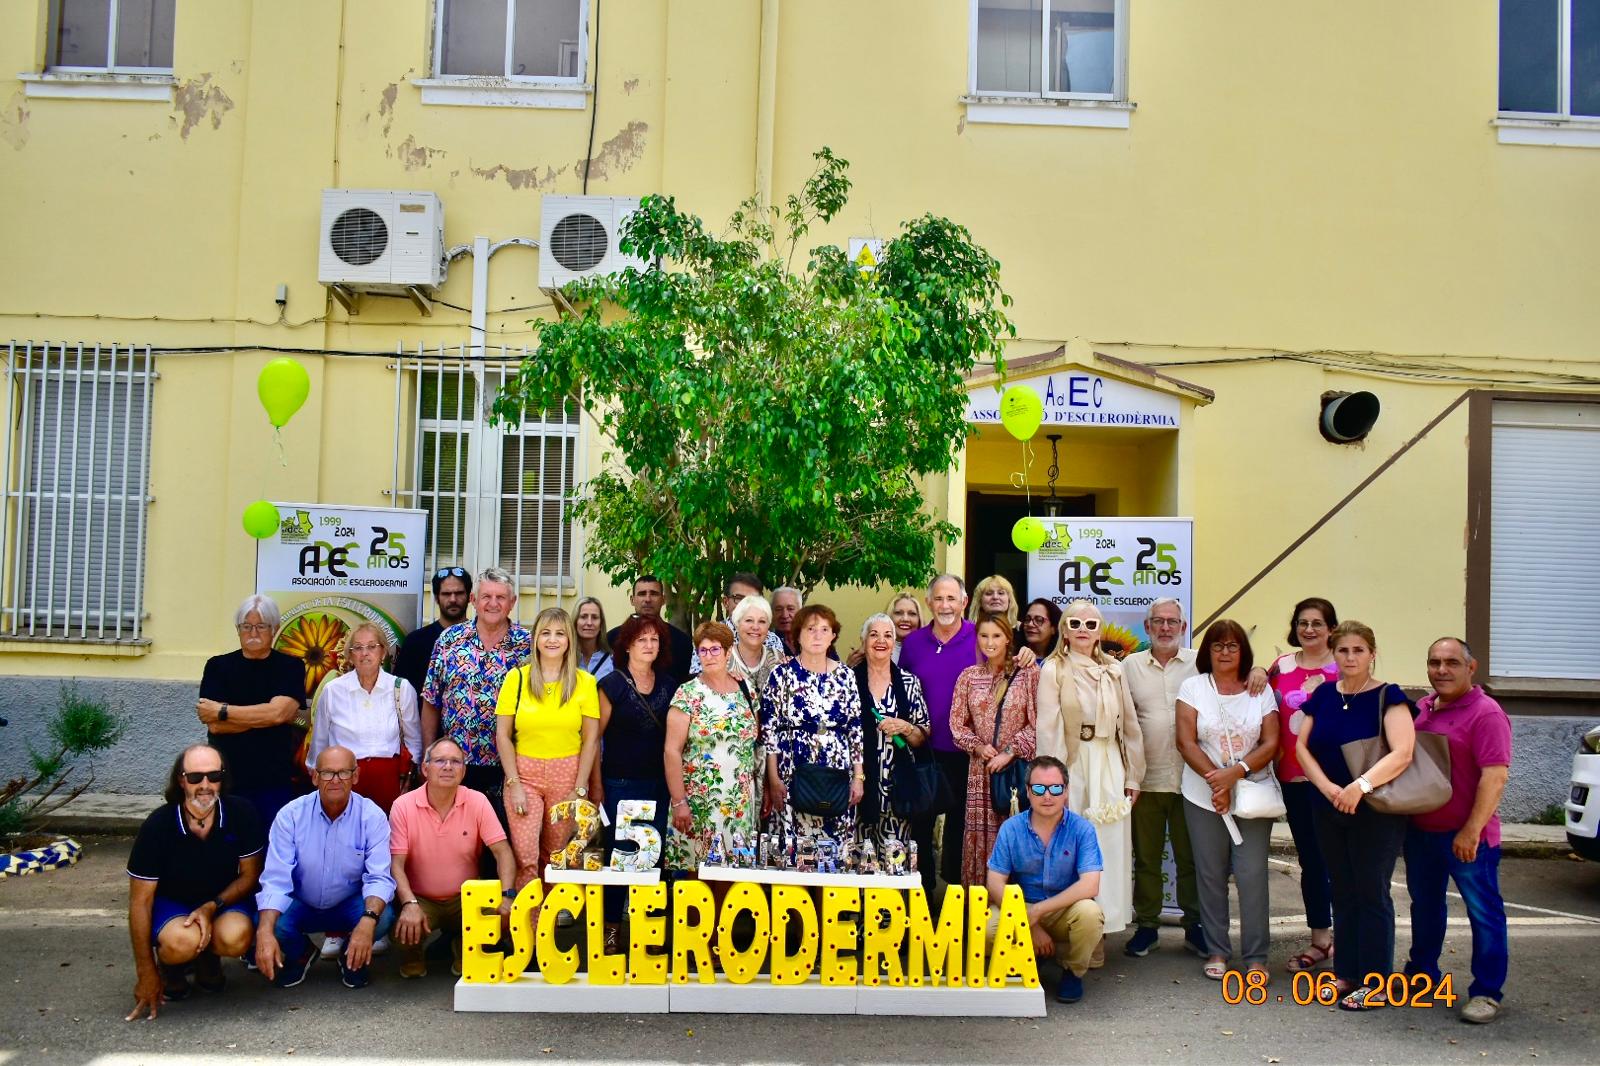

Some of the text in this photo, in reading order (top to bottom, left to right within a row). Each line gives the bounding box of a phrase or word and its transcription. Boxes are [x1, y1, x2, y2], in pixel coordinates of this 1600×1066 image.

[971, 408, 1176, 426] ASSOÓ D'ESCLERODÈRMIA
[371, 526, 406, 561] 25
[1136, 537, 1177, 574] 25
[349, 579, 408, 588] ESCLERODERMIA
[1051, 595, 1098, 606] ASOCIÓN
[1100, 597, 1112, 605] DE
[549, 799, 662, 872] 25
[460, 878, 1040, 988] ESCLERODERMIA
